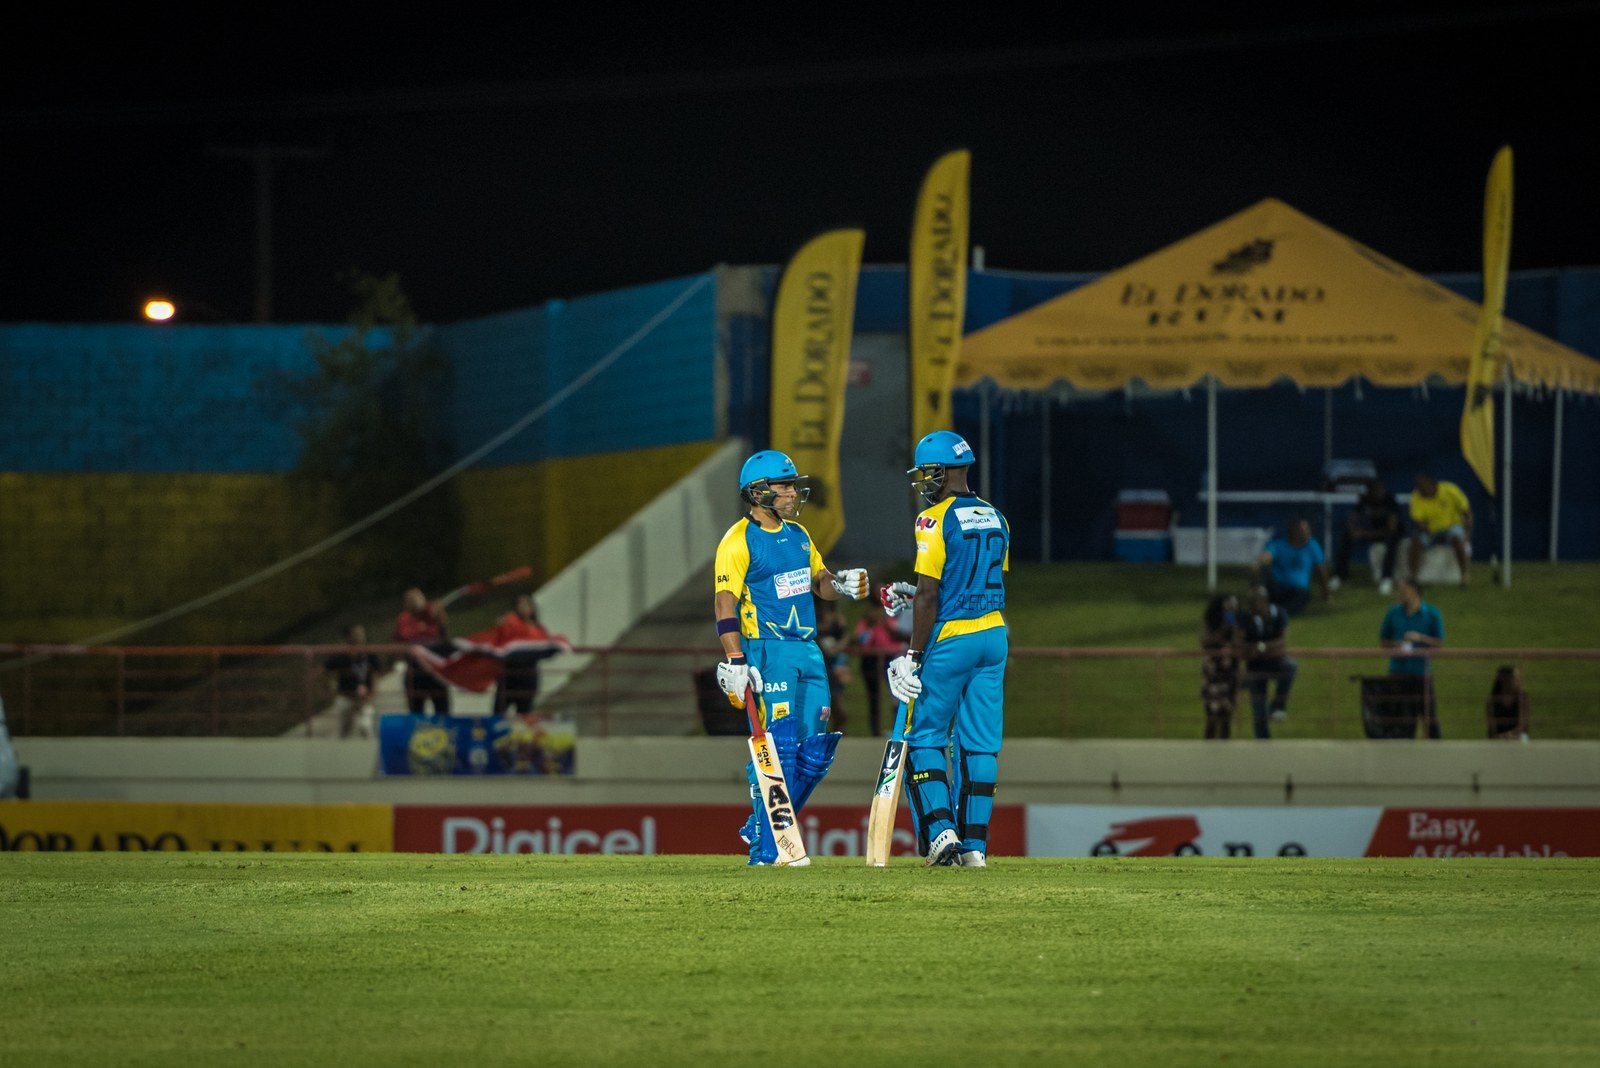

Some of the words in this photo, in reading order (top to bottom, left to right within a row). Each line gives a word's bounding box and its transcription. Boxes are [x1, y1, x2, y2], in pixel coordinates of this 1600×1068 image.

[795, 271, 835, 403] DORADO
[791, 418, 827, 451] EL
[963, 531, 1005, 589] 72
[716, 574, 730, 584] BA
[787, 569, 808, 579] GLOBAL
[789, 576, 809, 587] SPORTS
[764, 681, 788, 693] BAS
[912, 772, 929, 781] BAS
[768, 783, 794, 831] AS
[1407, 811, 1480, 845] Easy,
